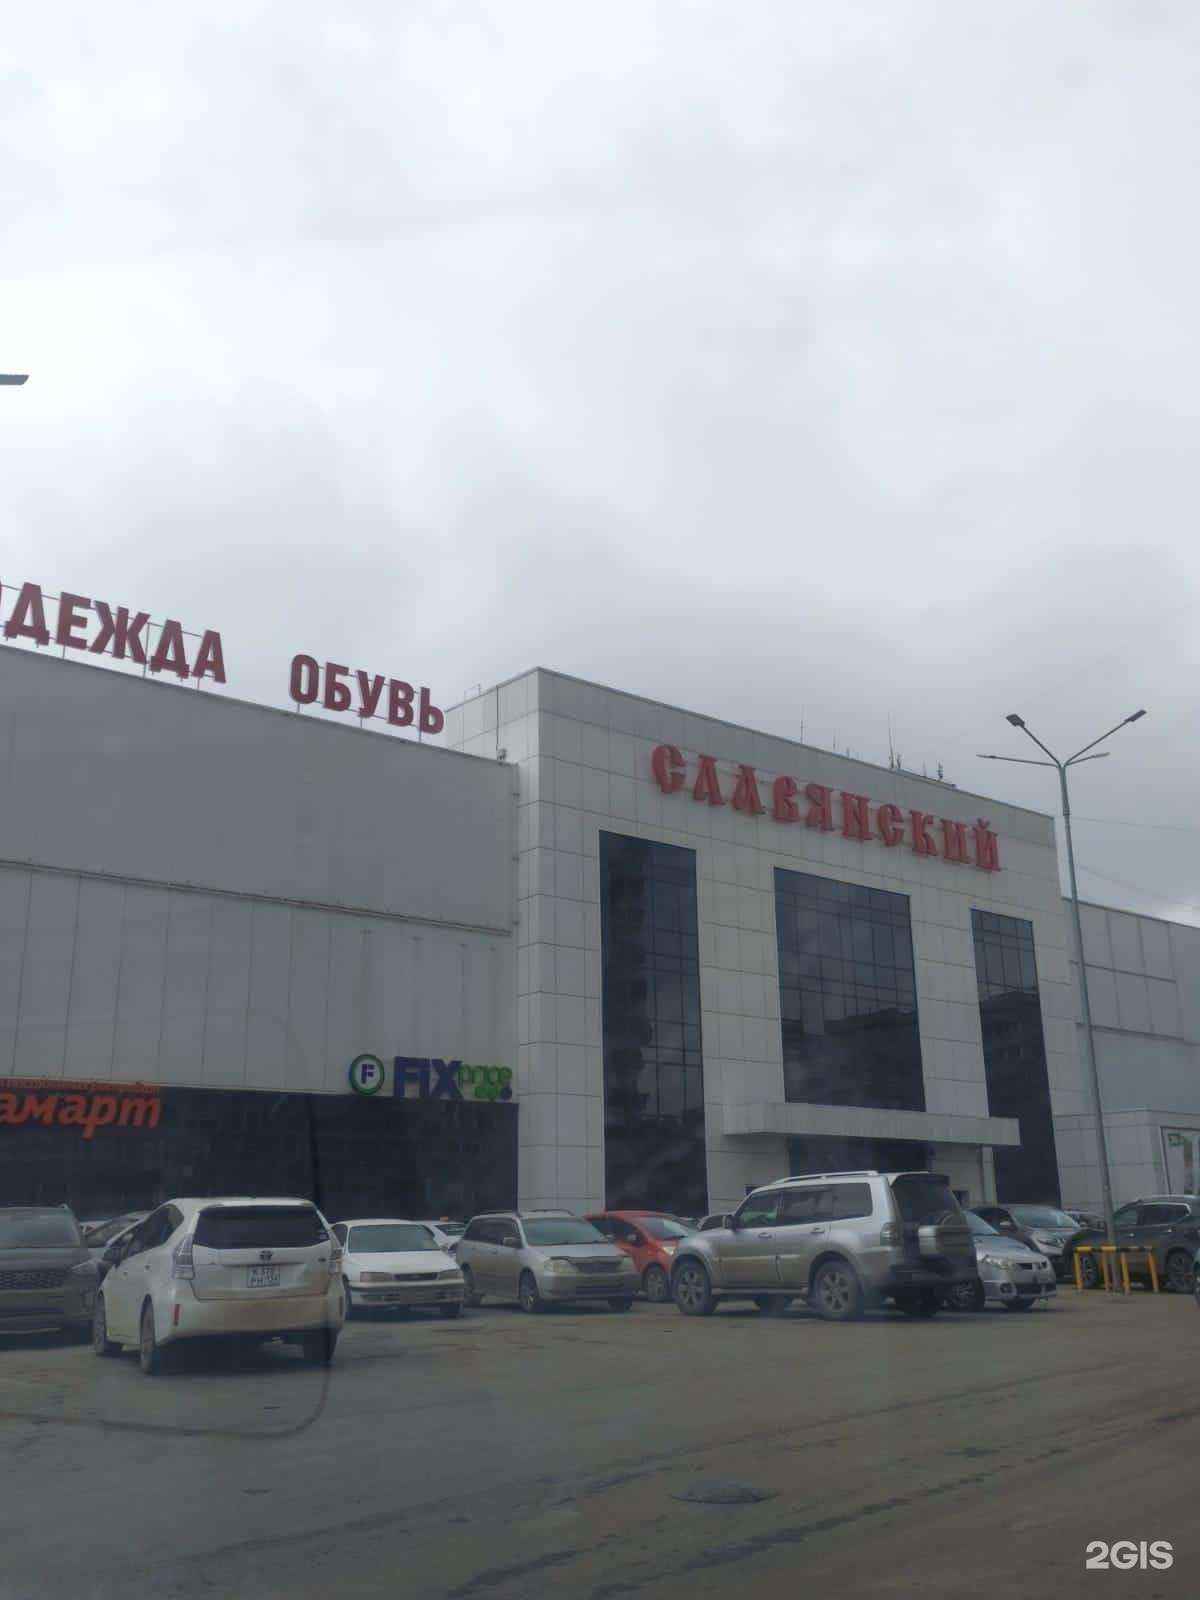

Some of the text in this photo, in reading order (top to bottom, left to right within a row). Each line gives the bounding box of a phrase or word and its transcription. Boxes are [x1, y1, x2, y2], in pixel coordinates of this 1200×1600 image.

[0, 581, 445, 734] ДЕЖДА ОБУВЬ
[651, 744, 1002, 872] СЛАВЯНСКИЙ
